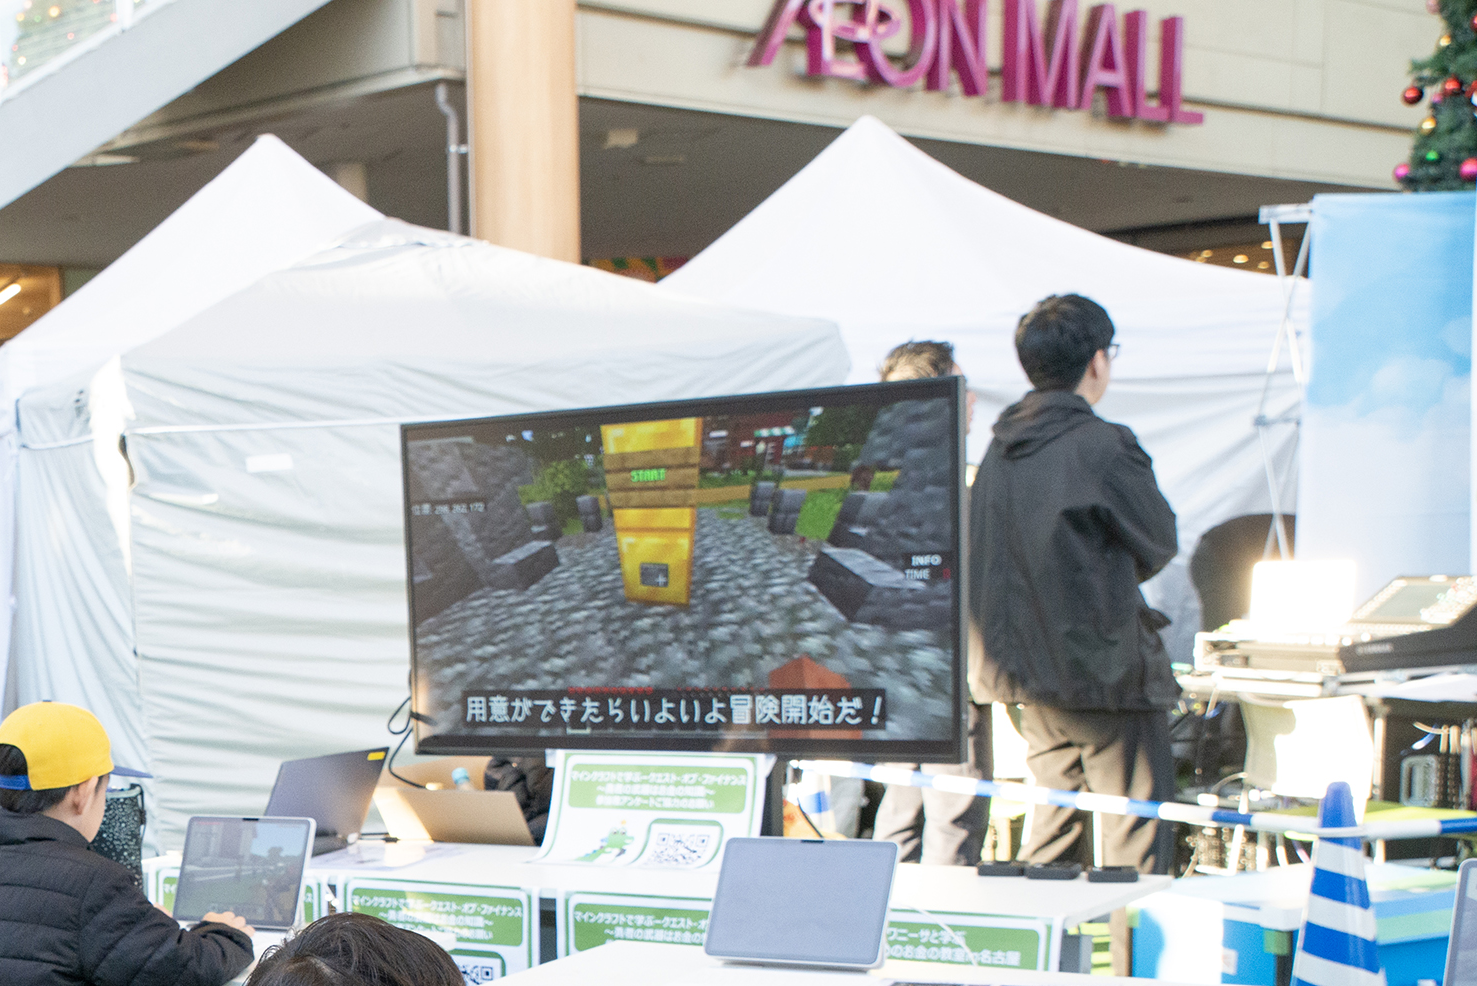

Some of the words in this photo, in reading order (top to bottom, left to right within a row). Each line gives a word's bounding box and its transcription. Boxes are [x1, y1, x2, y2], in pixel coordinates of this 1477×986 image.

[1002, 0, 1203, 124] MALL
[630, 468, 667, 482] START
[911, 554, 942, 567] INFO
[905, 568, 930, 580] TIME
[466, 694, 882, 726] 用意ができたらいよいよ冒険開始だ！
